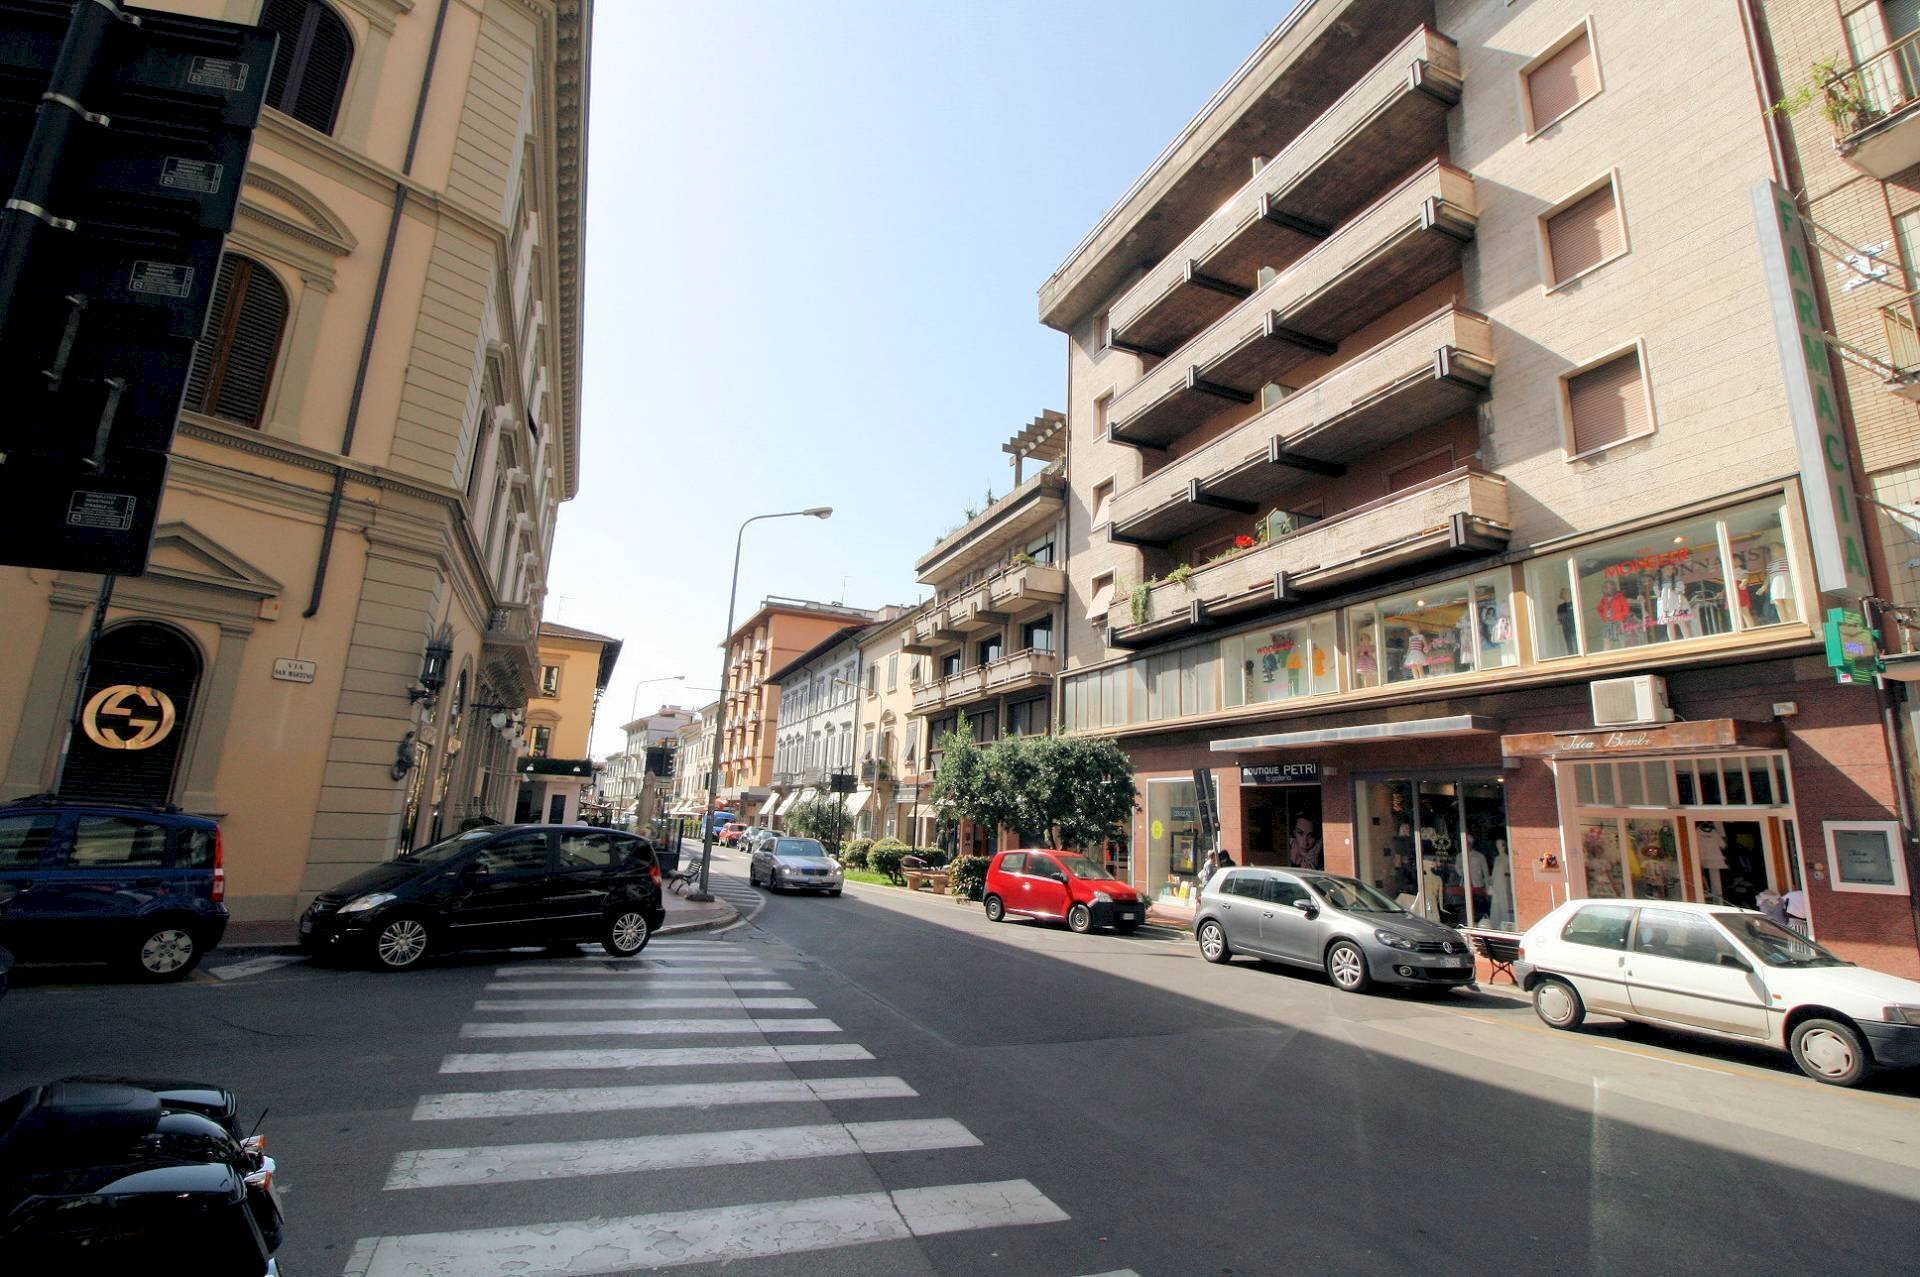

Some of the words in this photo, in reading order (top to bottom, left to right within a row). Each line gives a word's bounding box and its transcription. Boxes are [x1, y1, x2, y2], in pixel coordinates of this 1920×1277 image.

[1779, 200, 1866, 577] FARMACIA
[287, 662, 303, 671] VIA
[1243, 766, 1280, 776] BOUTIQUE
[1283, 763, 1316, 775] PETRI
